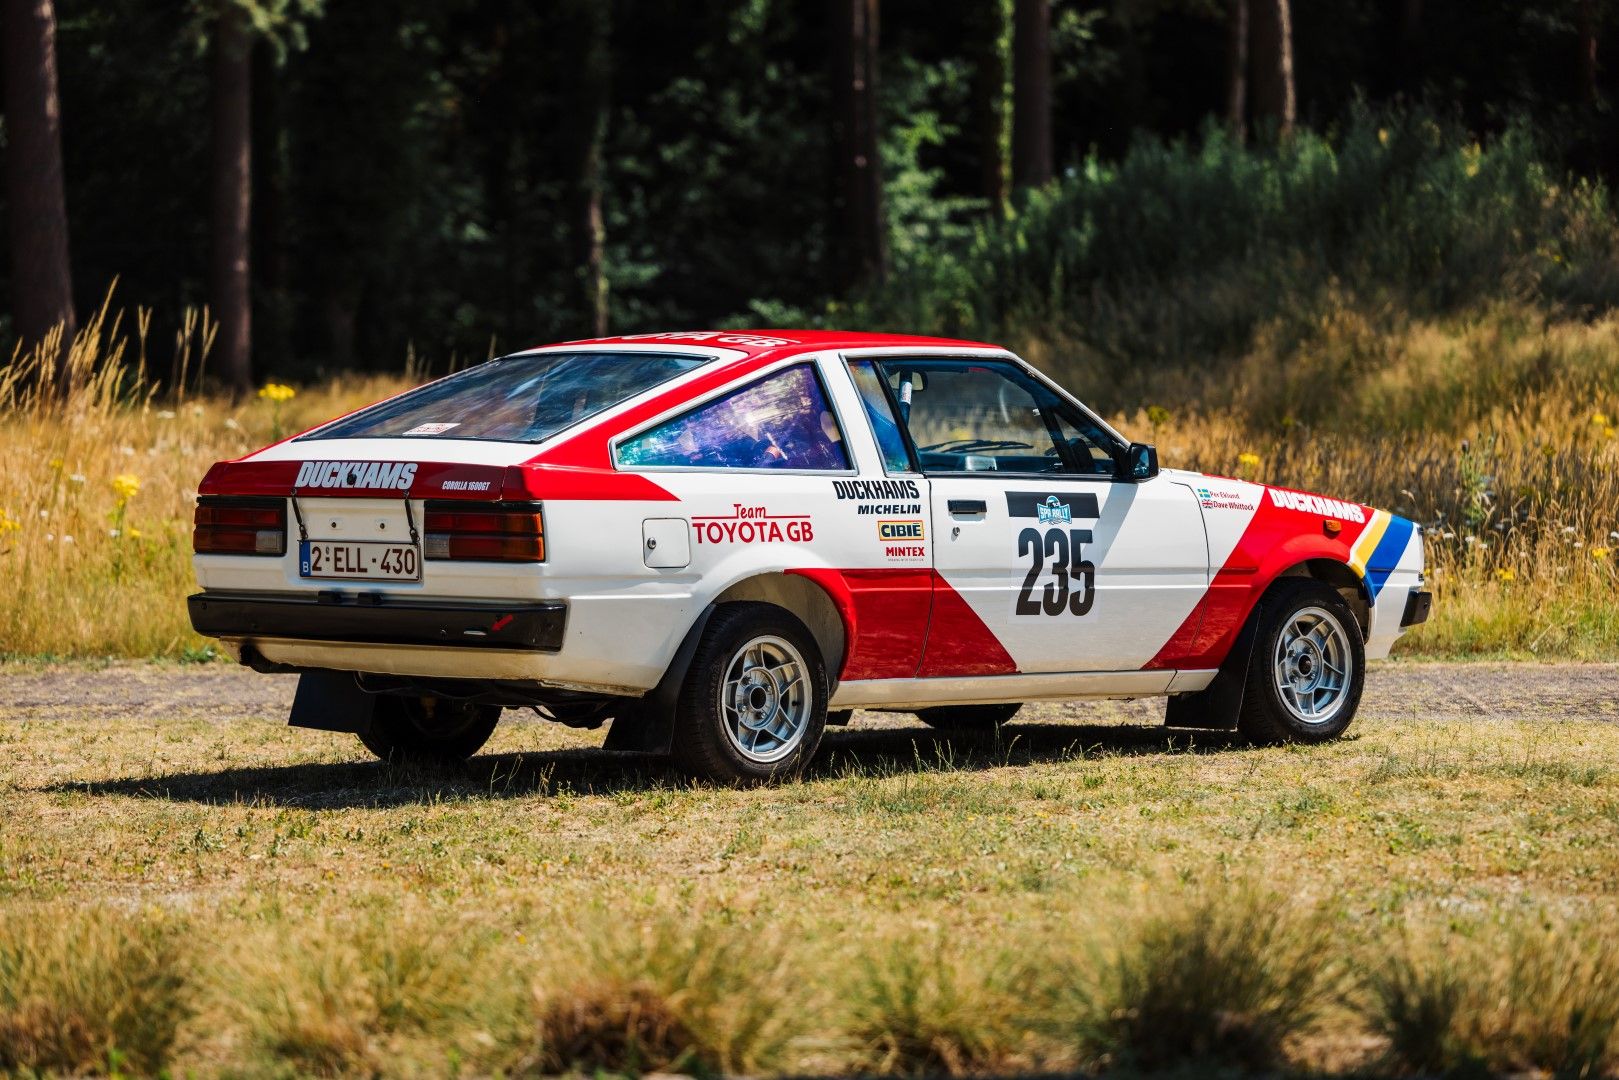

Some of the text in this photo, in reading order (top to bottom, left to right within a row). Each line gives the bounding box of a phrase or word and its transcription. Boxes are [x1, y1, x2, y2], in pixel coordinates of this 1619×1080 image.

[294, 461, 418, 489] DUCKHAMS
[442, 481, 468, 491] COROLLA
[832, 480, 920, 500] DUCKHAMS
[733, 503, 766, 519] Team
[858, 504, 921, 515] MICHELIN
[1267, 488, 1366, 524] DUCKHAMS
[692, 521, 814, 544] TOYOTA GB
[886, 546, 925, 557] MINTEX
[302, 561, 309, 573] B
[1016, 528, 1095, 616] 235
